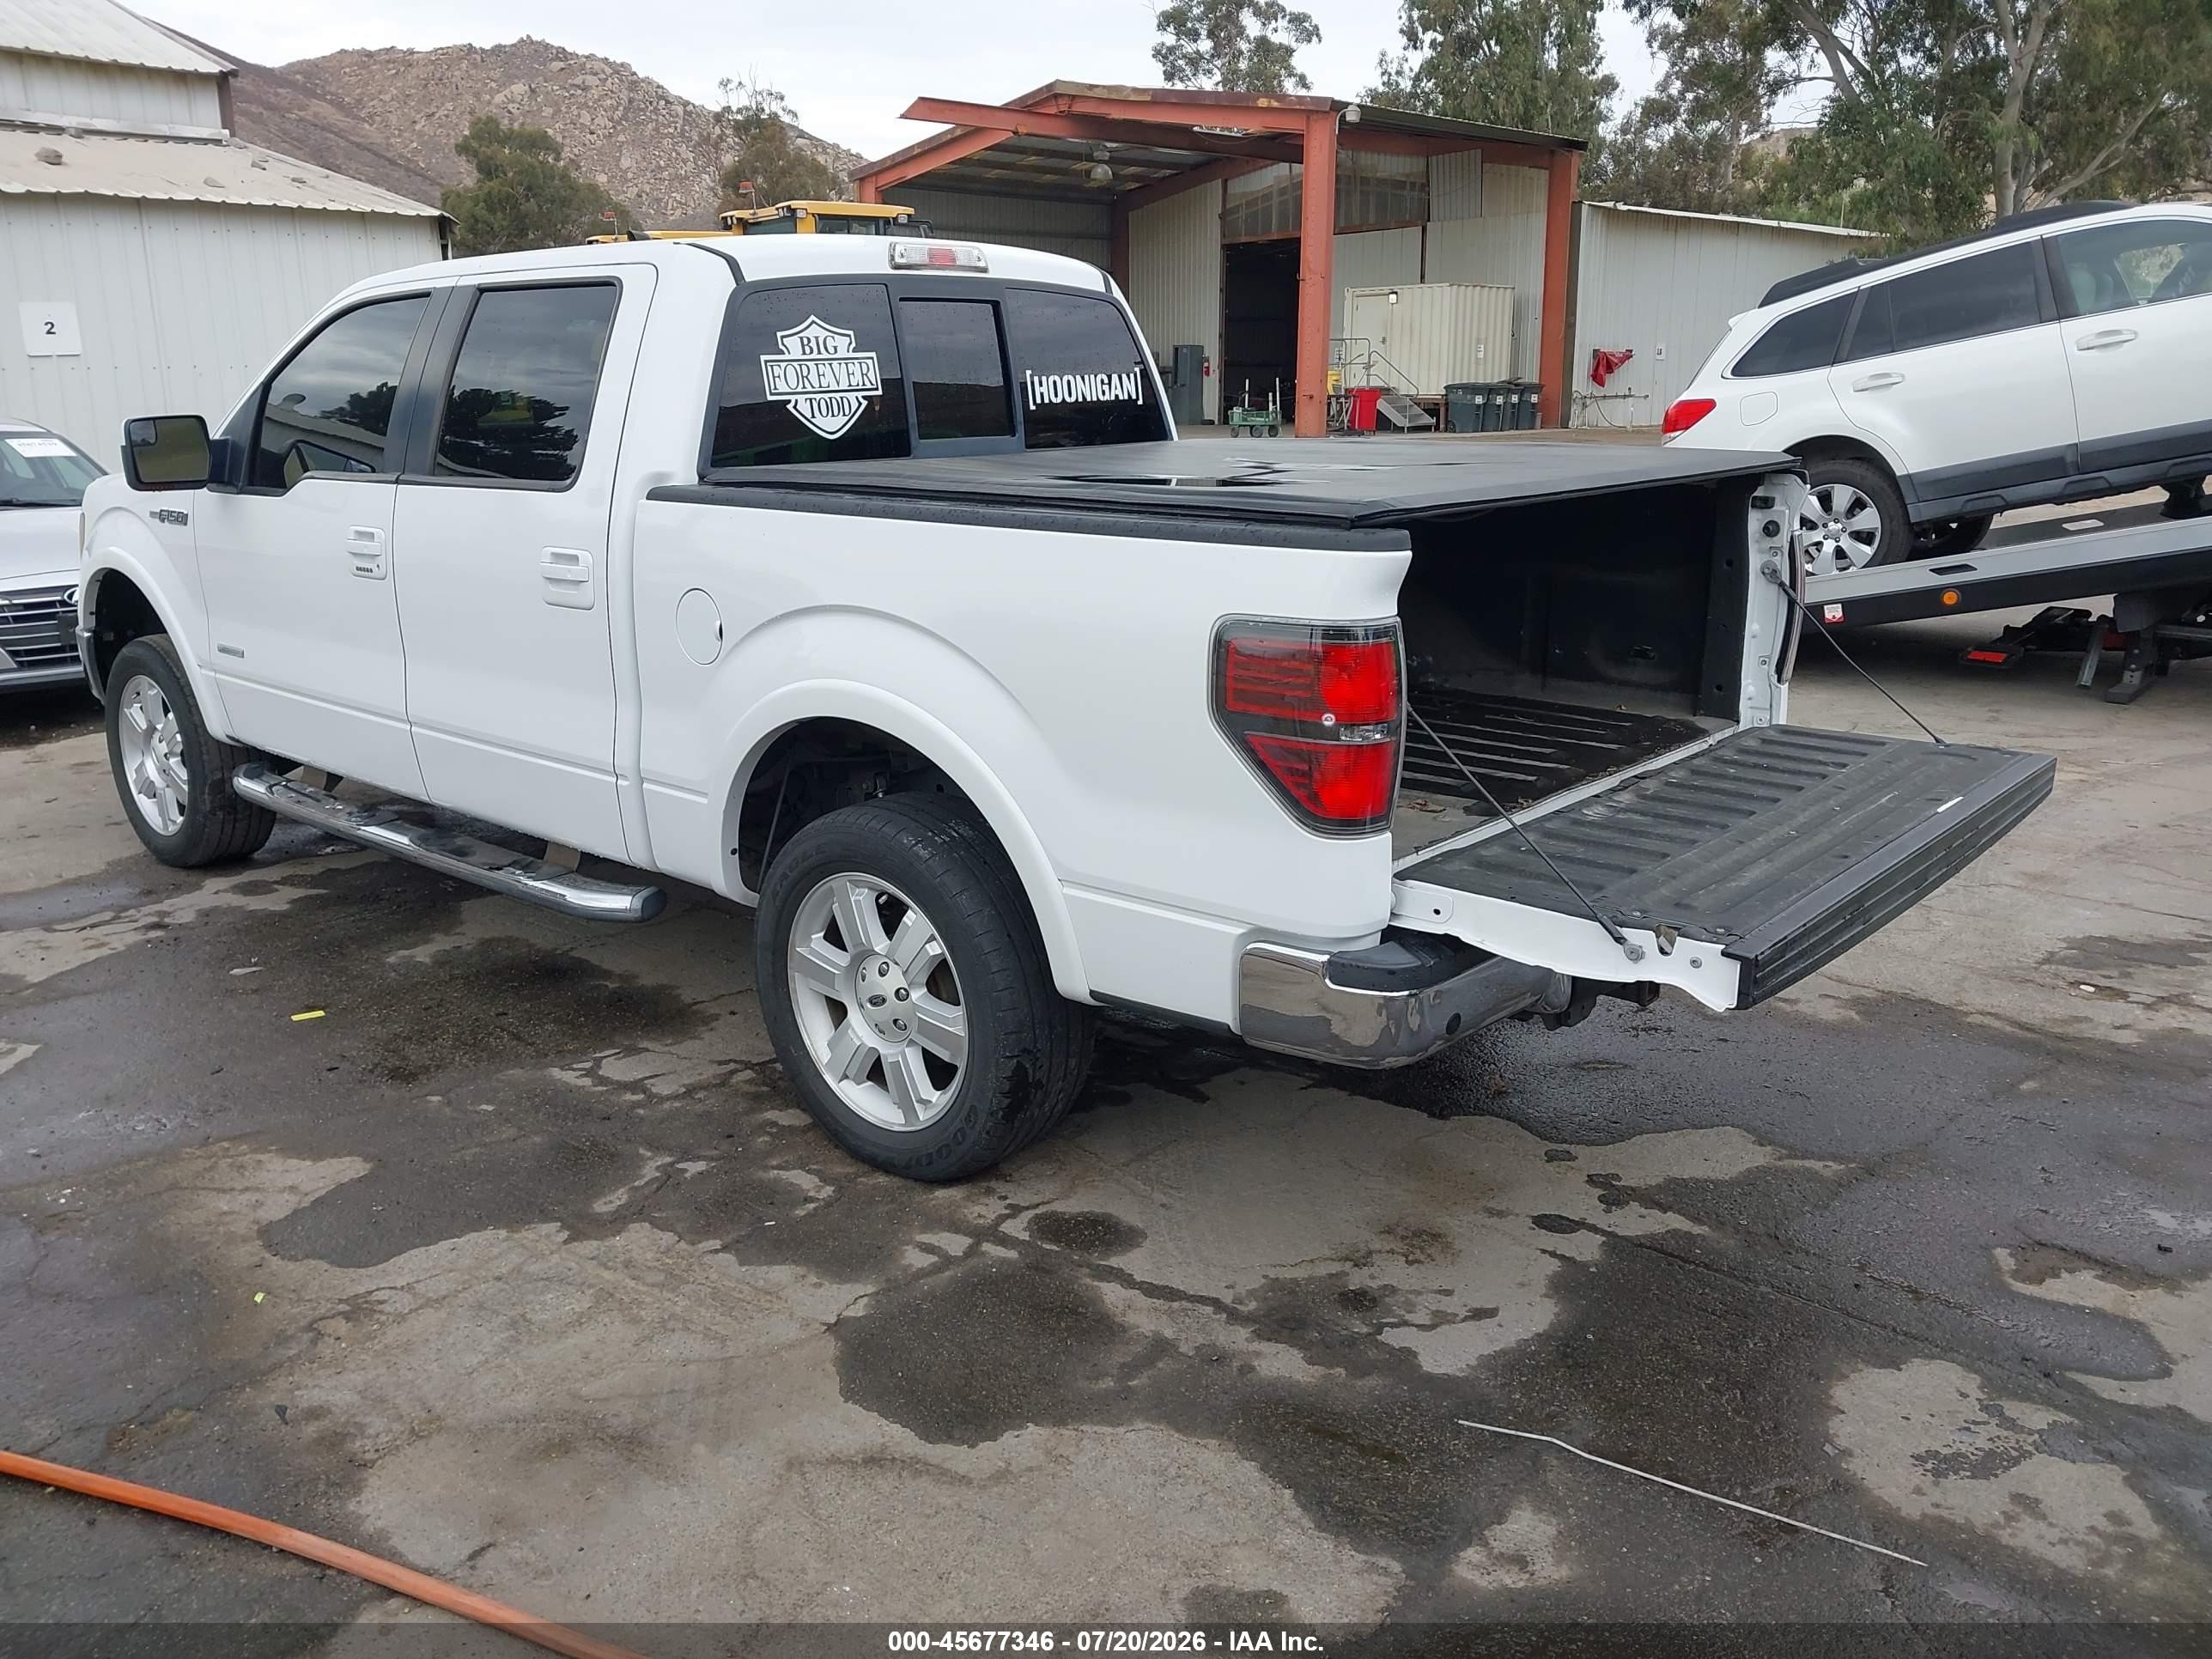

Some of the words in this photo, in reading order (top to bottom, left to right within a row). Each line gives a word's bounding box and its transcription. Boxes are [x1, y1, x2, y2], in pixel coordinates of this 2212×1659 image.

[44, 321, 57, 335] 2
[798, 335, 839, 356] BIG
[768, 361, 876, 391] FOREVER
[805, 396, 852, 419] TODD
